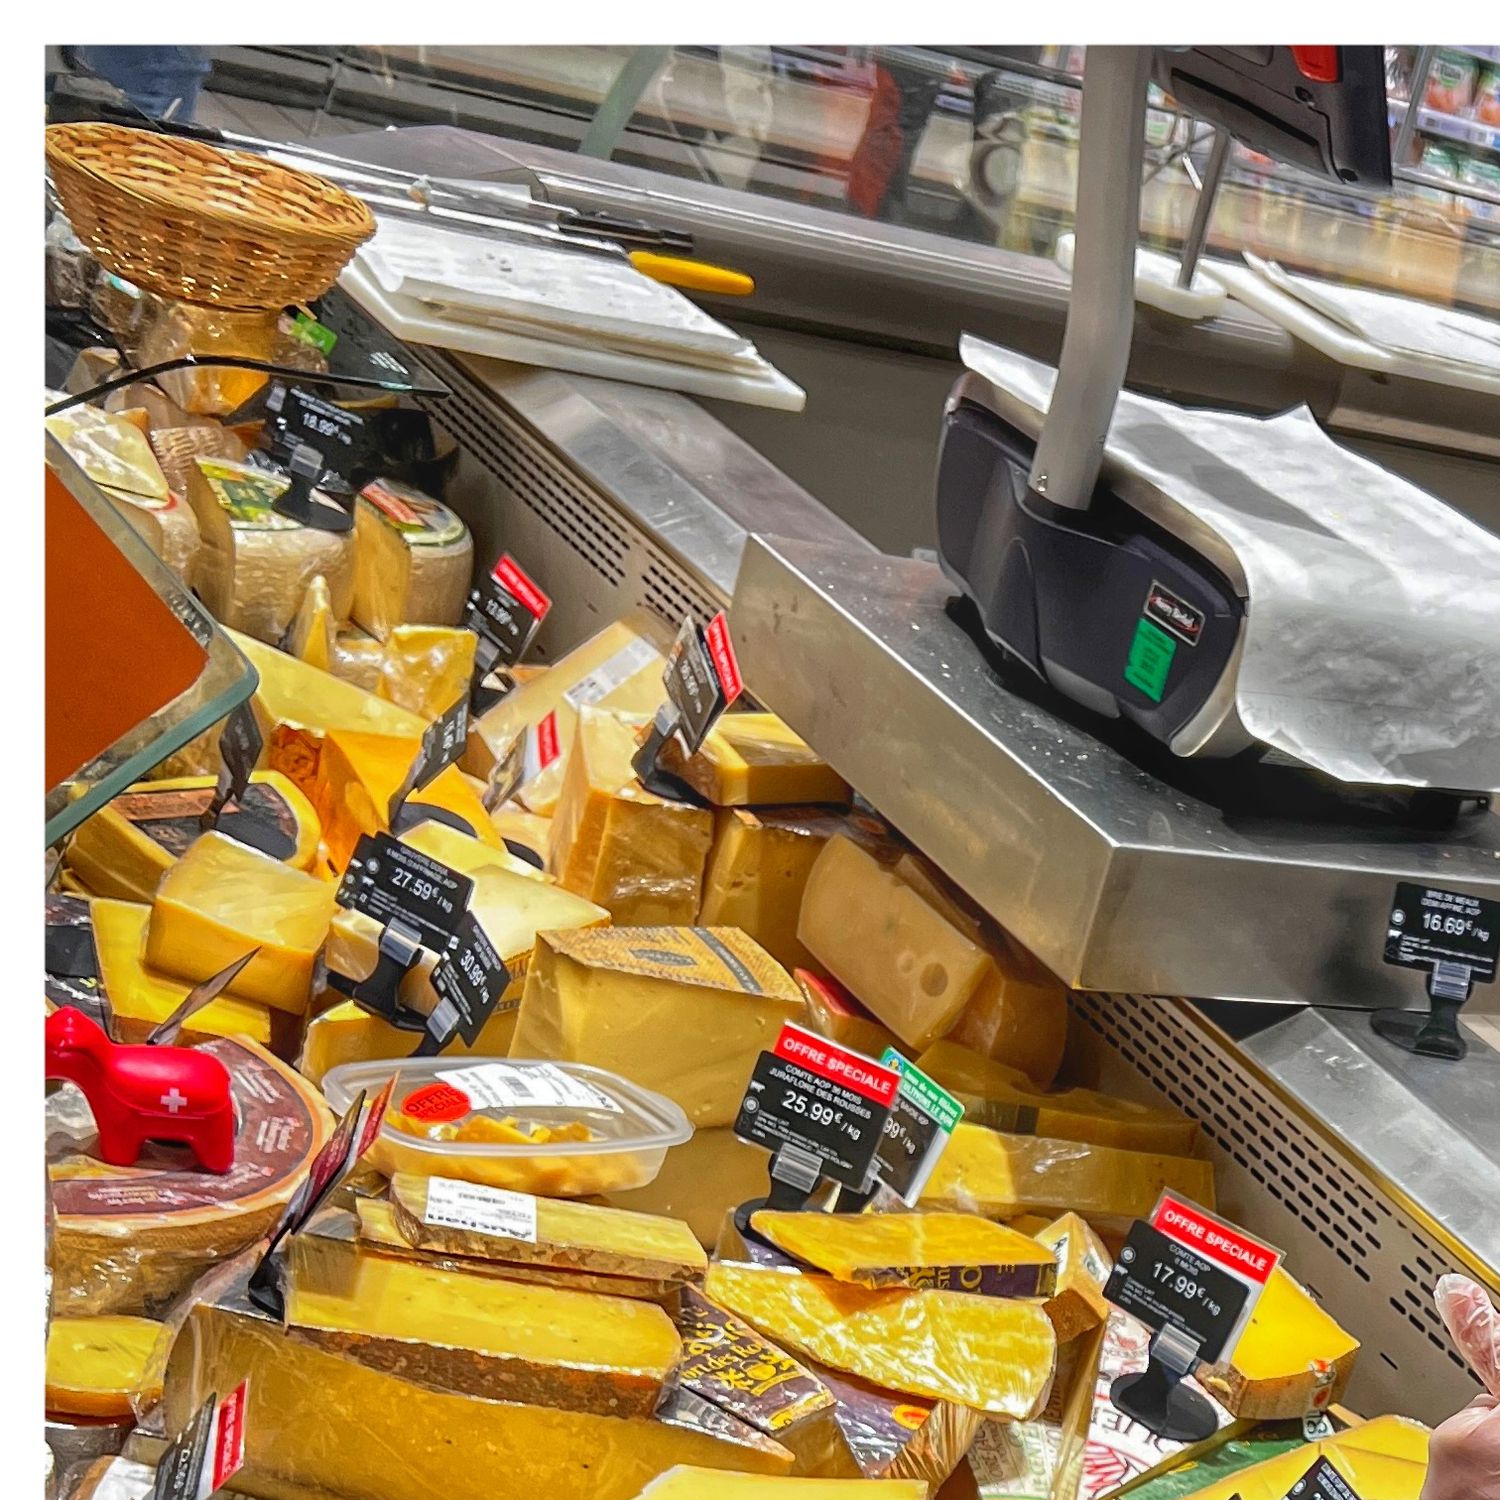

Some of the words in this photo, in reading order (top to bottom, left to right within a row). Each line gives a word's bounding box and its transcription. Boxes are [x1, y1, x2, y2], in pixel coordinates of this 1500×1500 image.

[782, 1036, 826, 1067] OFFRE
[826, 1054, 891, 1095] SPECIALE
[1163, 1209, 1206, 1239] OFFRE
[1204, 1231, 1267, 1273] SPECIALE
[1152, 1261, 1206, 1300] 17.99€
